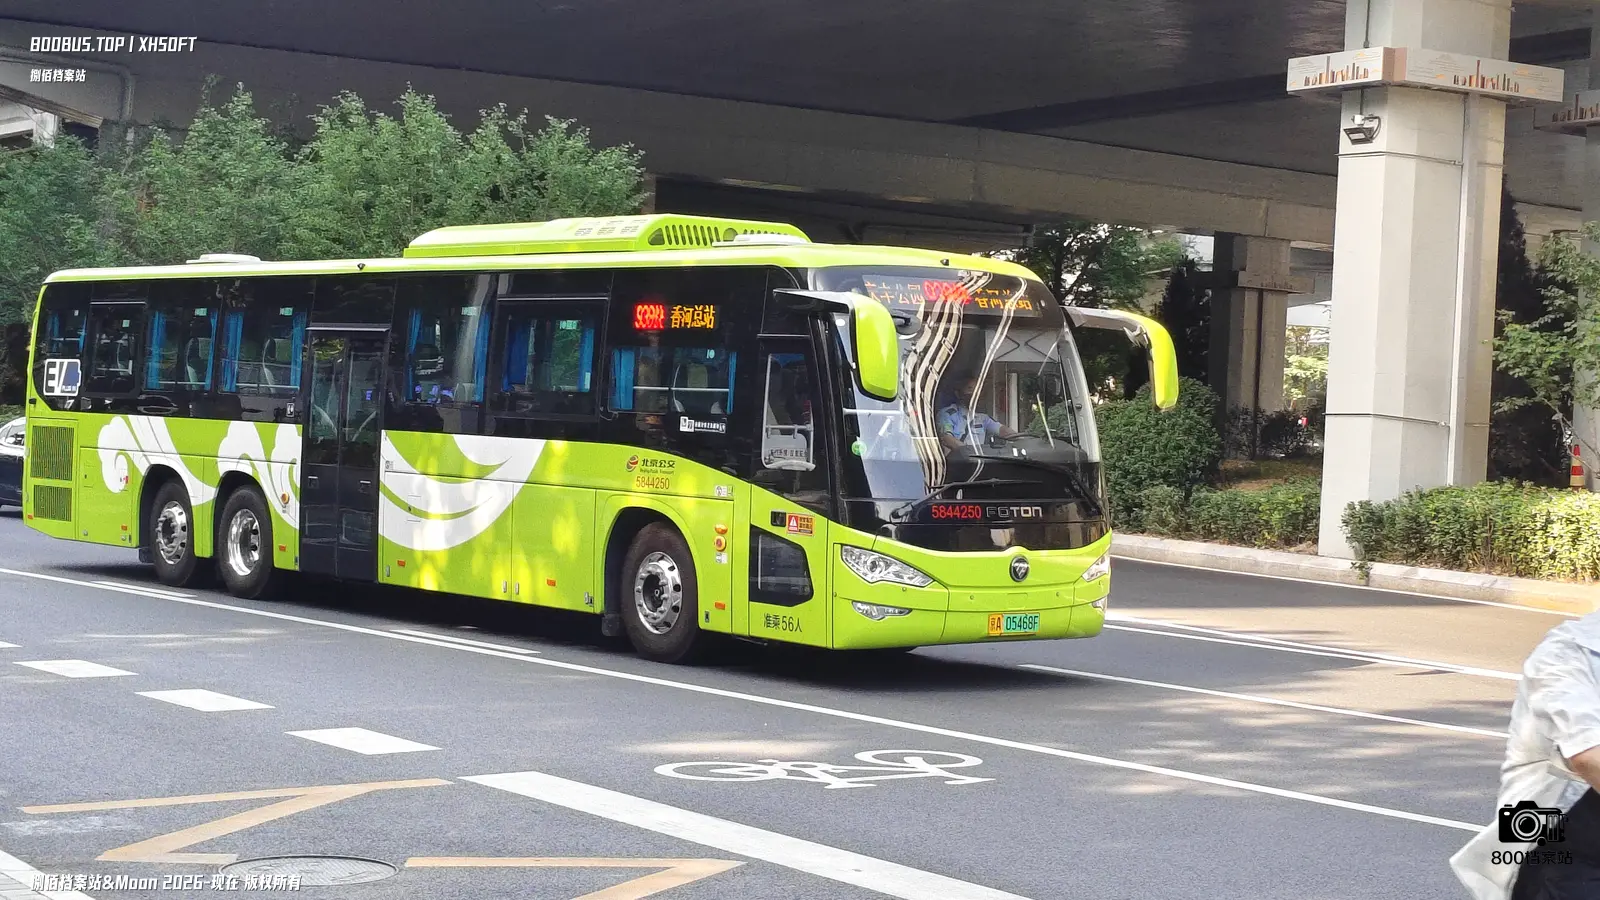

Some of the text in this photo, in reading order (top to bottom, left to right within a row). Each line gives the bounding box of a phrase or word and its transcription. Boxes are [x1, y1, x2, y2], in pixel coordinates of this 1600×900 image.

[670, 304, 716, 329] 香河总站
[641, 458, 675, 468] 北京公交
[635, 475, 670, 490] 5844250
[931, 505, 1042, 519] 5844250 FOTON
[1005, 615, 1039, 631] 05468F
